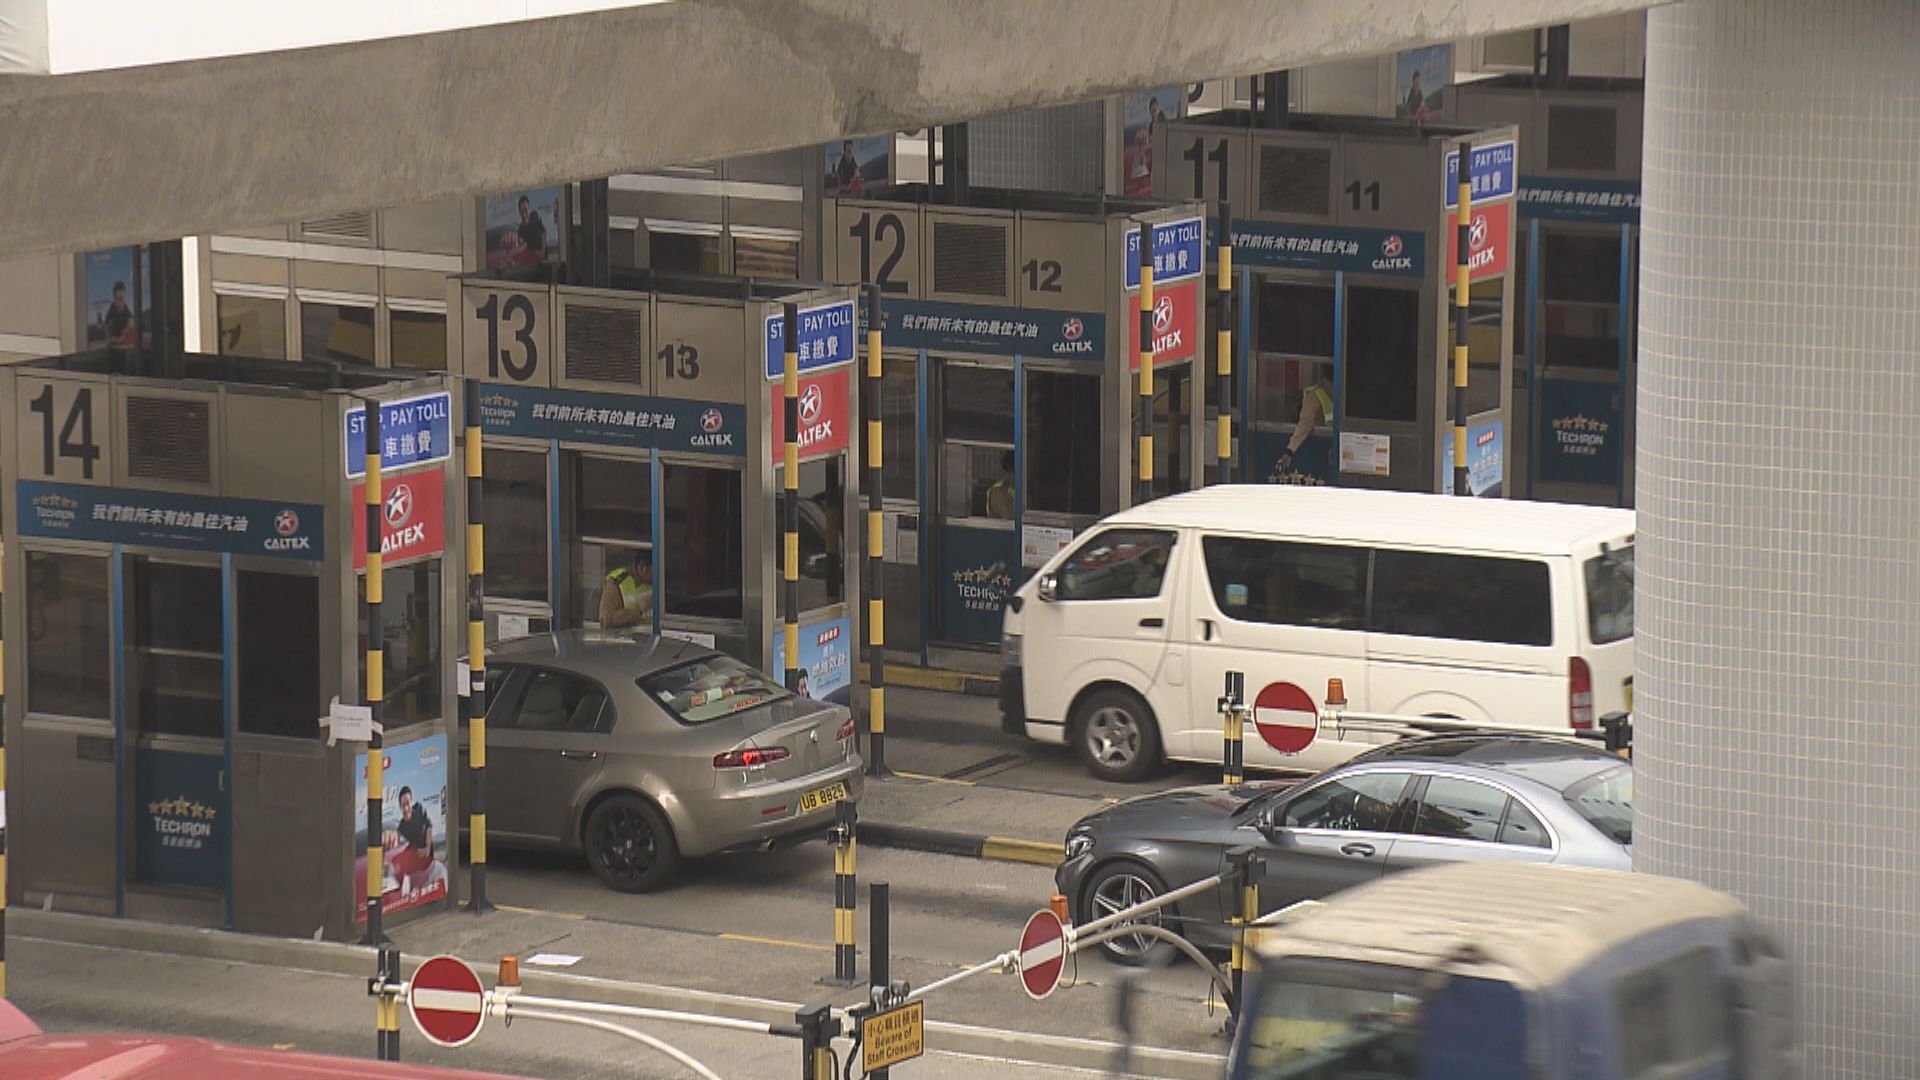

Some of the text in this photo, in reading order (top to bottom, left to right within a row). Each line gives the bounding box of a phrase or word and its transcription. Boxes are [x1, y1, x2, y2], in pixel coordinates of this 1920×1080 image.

[1184, 138, 1229, 202] 11
[1475, 152, 1491, 168] PAY
[1493, 147, 1511, 165] TOLL
[1346, 181, 1379, 211] 11
[1158, 230, 1176, 247] PAY
[1178, 226, 1199, 243] TOLL
[849, 212, 908, 294] 12
[1372, 257, 1411, 270] CALTEX
[1468, 246, 1494, 271] LTEX
[1022, 260, 1062, 293] 12
[476, 293, 538, 381] 13
[770, 322, 800, 340] ST.
[804, 314, 824, 334] PAY
[826, 308, 851, 328] TOLL
[799, 335, 839, 362] 車繳費
[1052, 340, 1093, 353] CALTEX
[1152, 328, 1182, 356] ALTEX
[658, 343, 700, 380] 13
[391, 407, 413, 428] PAY
[416, 401, 446, 421] TOLL
[30, 384, 100, 480] 14
[384, 429, 432, 460] 車繳費
[690, 433, 734, 446] CALTEX
[797, 419, 832, 449] ALTEX
[1556, 430, 1604, 446] TECHRON
[263, 536, 310, 550] CALTEX
[381, 521, 425, 554] ALTEX
[801, 793, 817, 810] UB
[154, 815, 211, 838] TECHRON
[874, 1026, 912, 1049] Beware of
[867, 1040, 920, 1065] Staff Crossing
